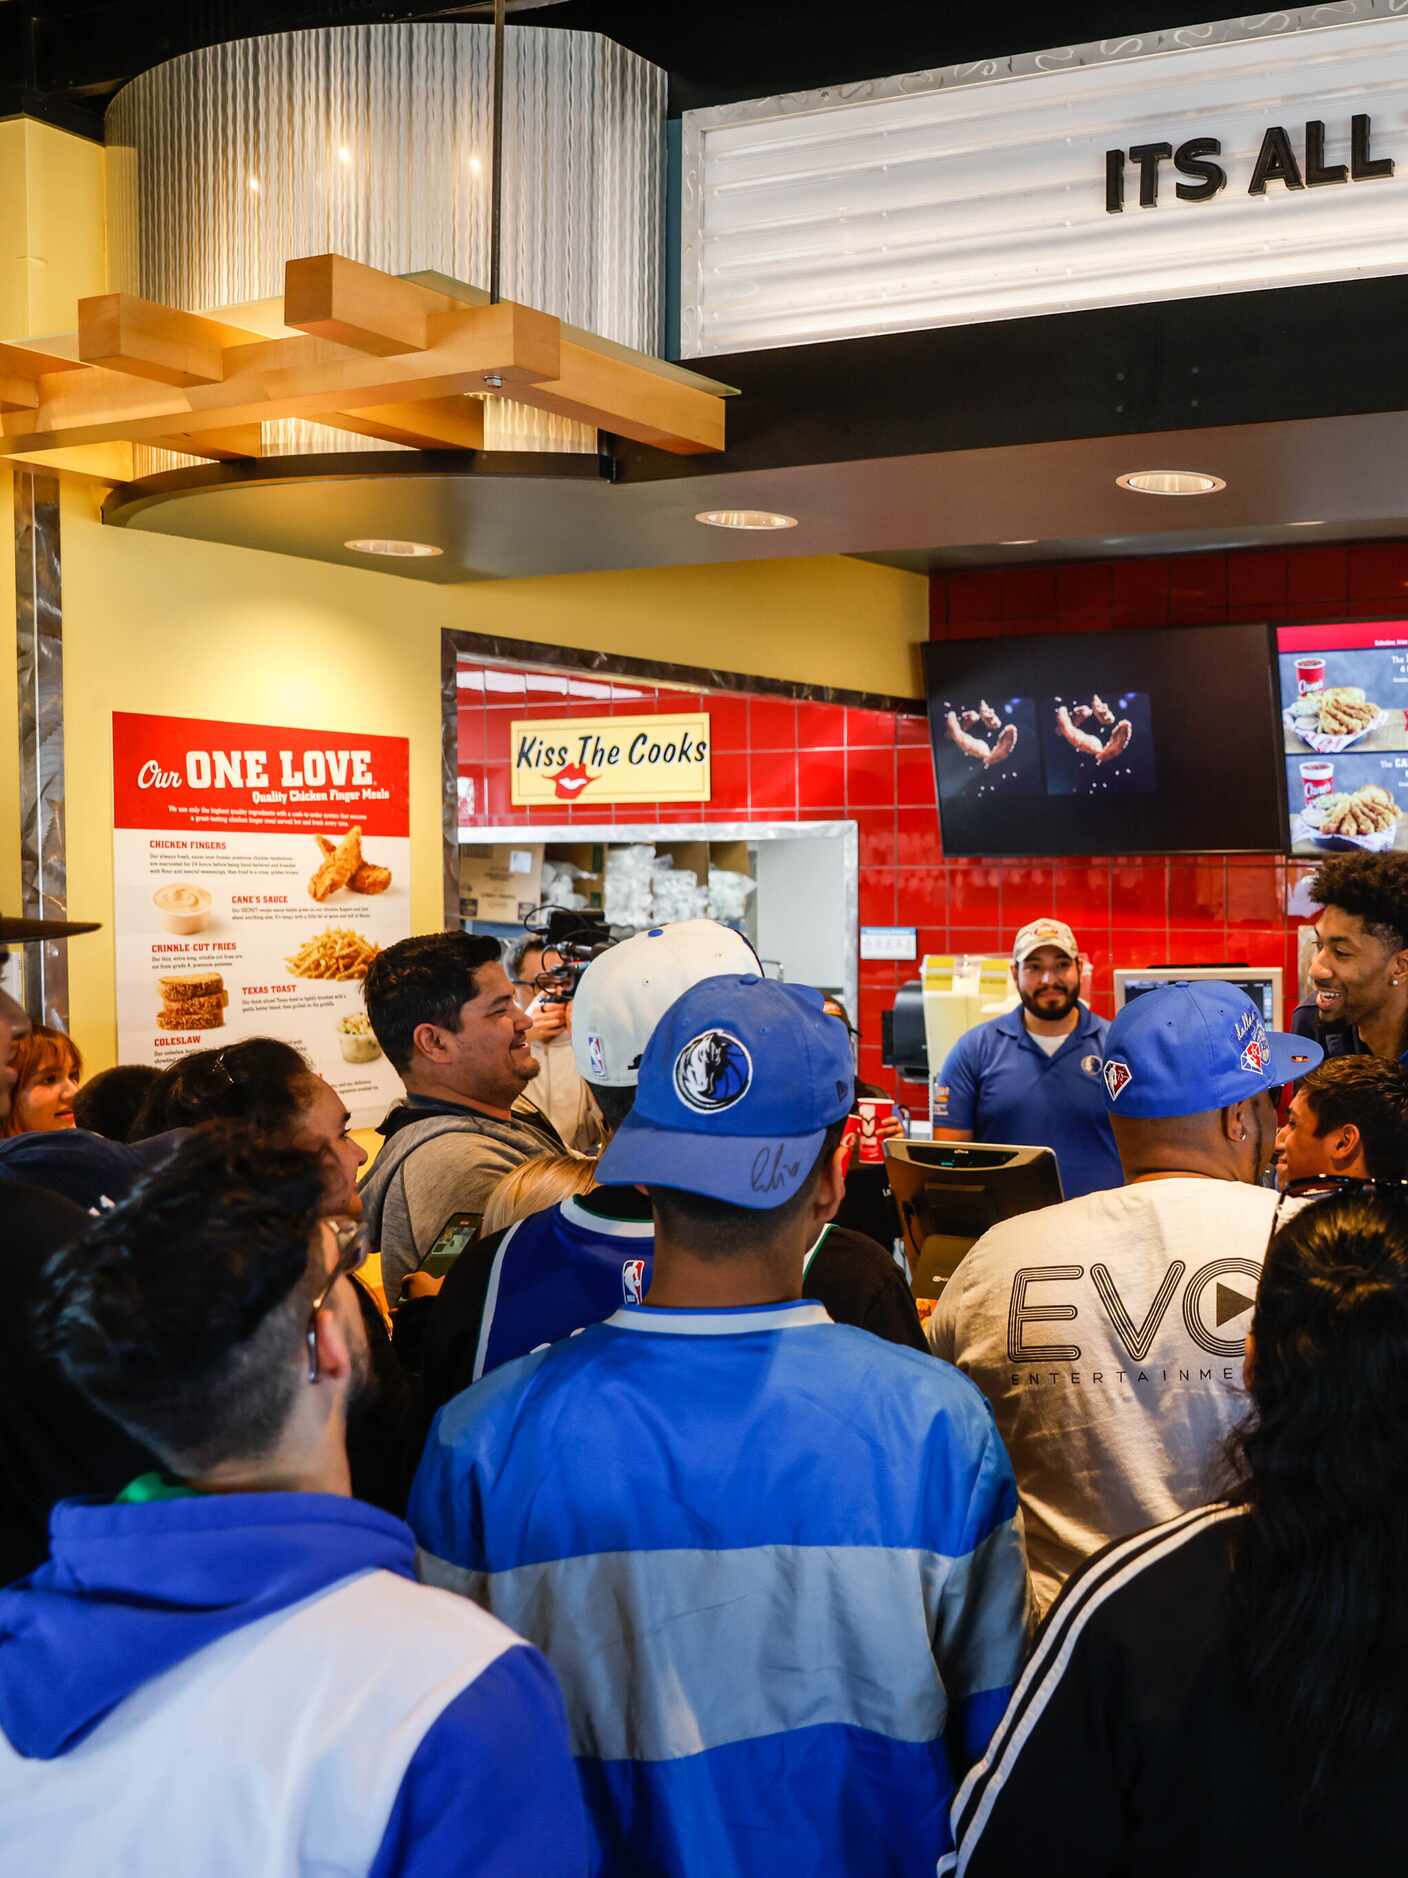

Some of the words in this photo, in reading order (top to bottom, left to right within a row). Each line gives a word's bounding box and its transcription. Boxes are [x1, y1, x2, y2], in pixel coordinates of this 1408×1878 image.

[1105, 137, 1227, 215] ITS
[1248, 114, 1393, 196] ALL
[516, 736, 568, 768] Kiss
[578, 735, 620, 767] The
[628, 732, 707, 765] Cooks
[137, 759, 182, 790] Our
[186, 750, 269, 789] ONE
[252, 791, 287, 805] Quality
[289, 789, 328, 802] Chicken
[329, 789, 359, 803] Finger
[361, 788, 390, 801] Meals
[150, 840, 188, 849] CHICKEN
[190, 841, 227, 850] FINGERS
[232, 896, 260, 904] CANE'S
[263, 896, 288, 904] SAUCE
[212, 943, 237, 951] FRIES
[242, 986, 269, 995] TEXAS
[271, 984, 297, 993] TOAST
[154, 1036, 201, 1047] COLESLAW
